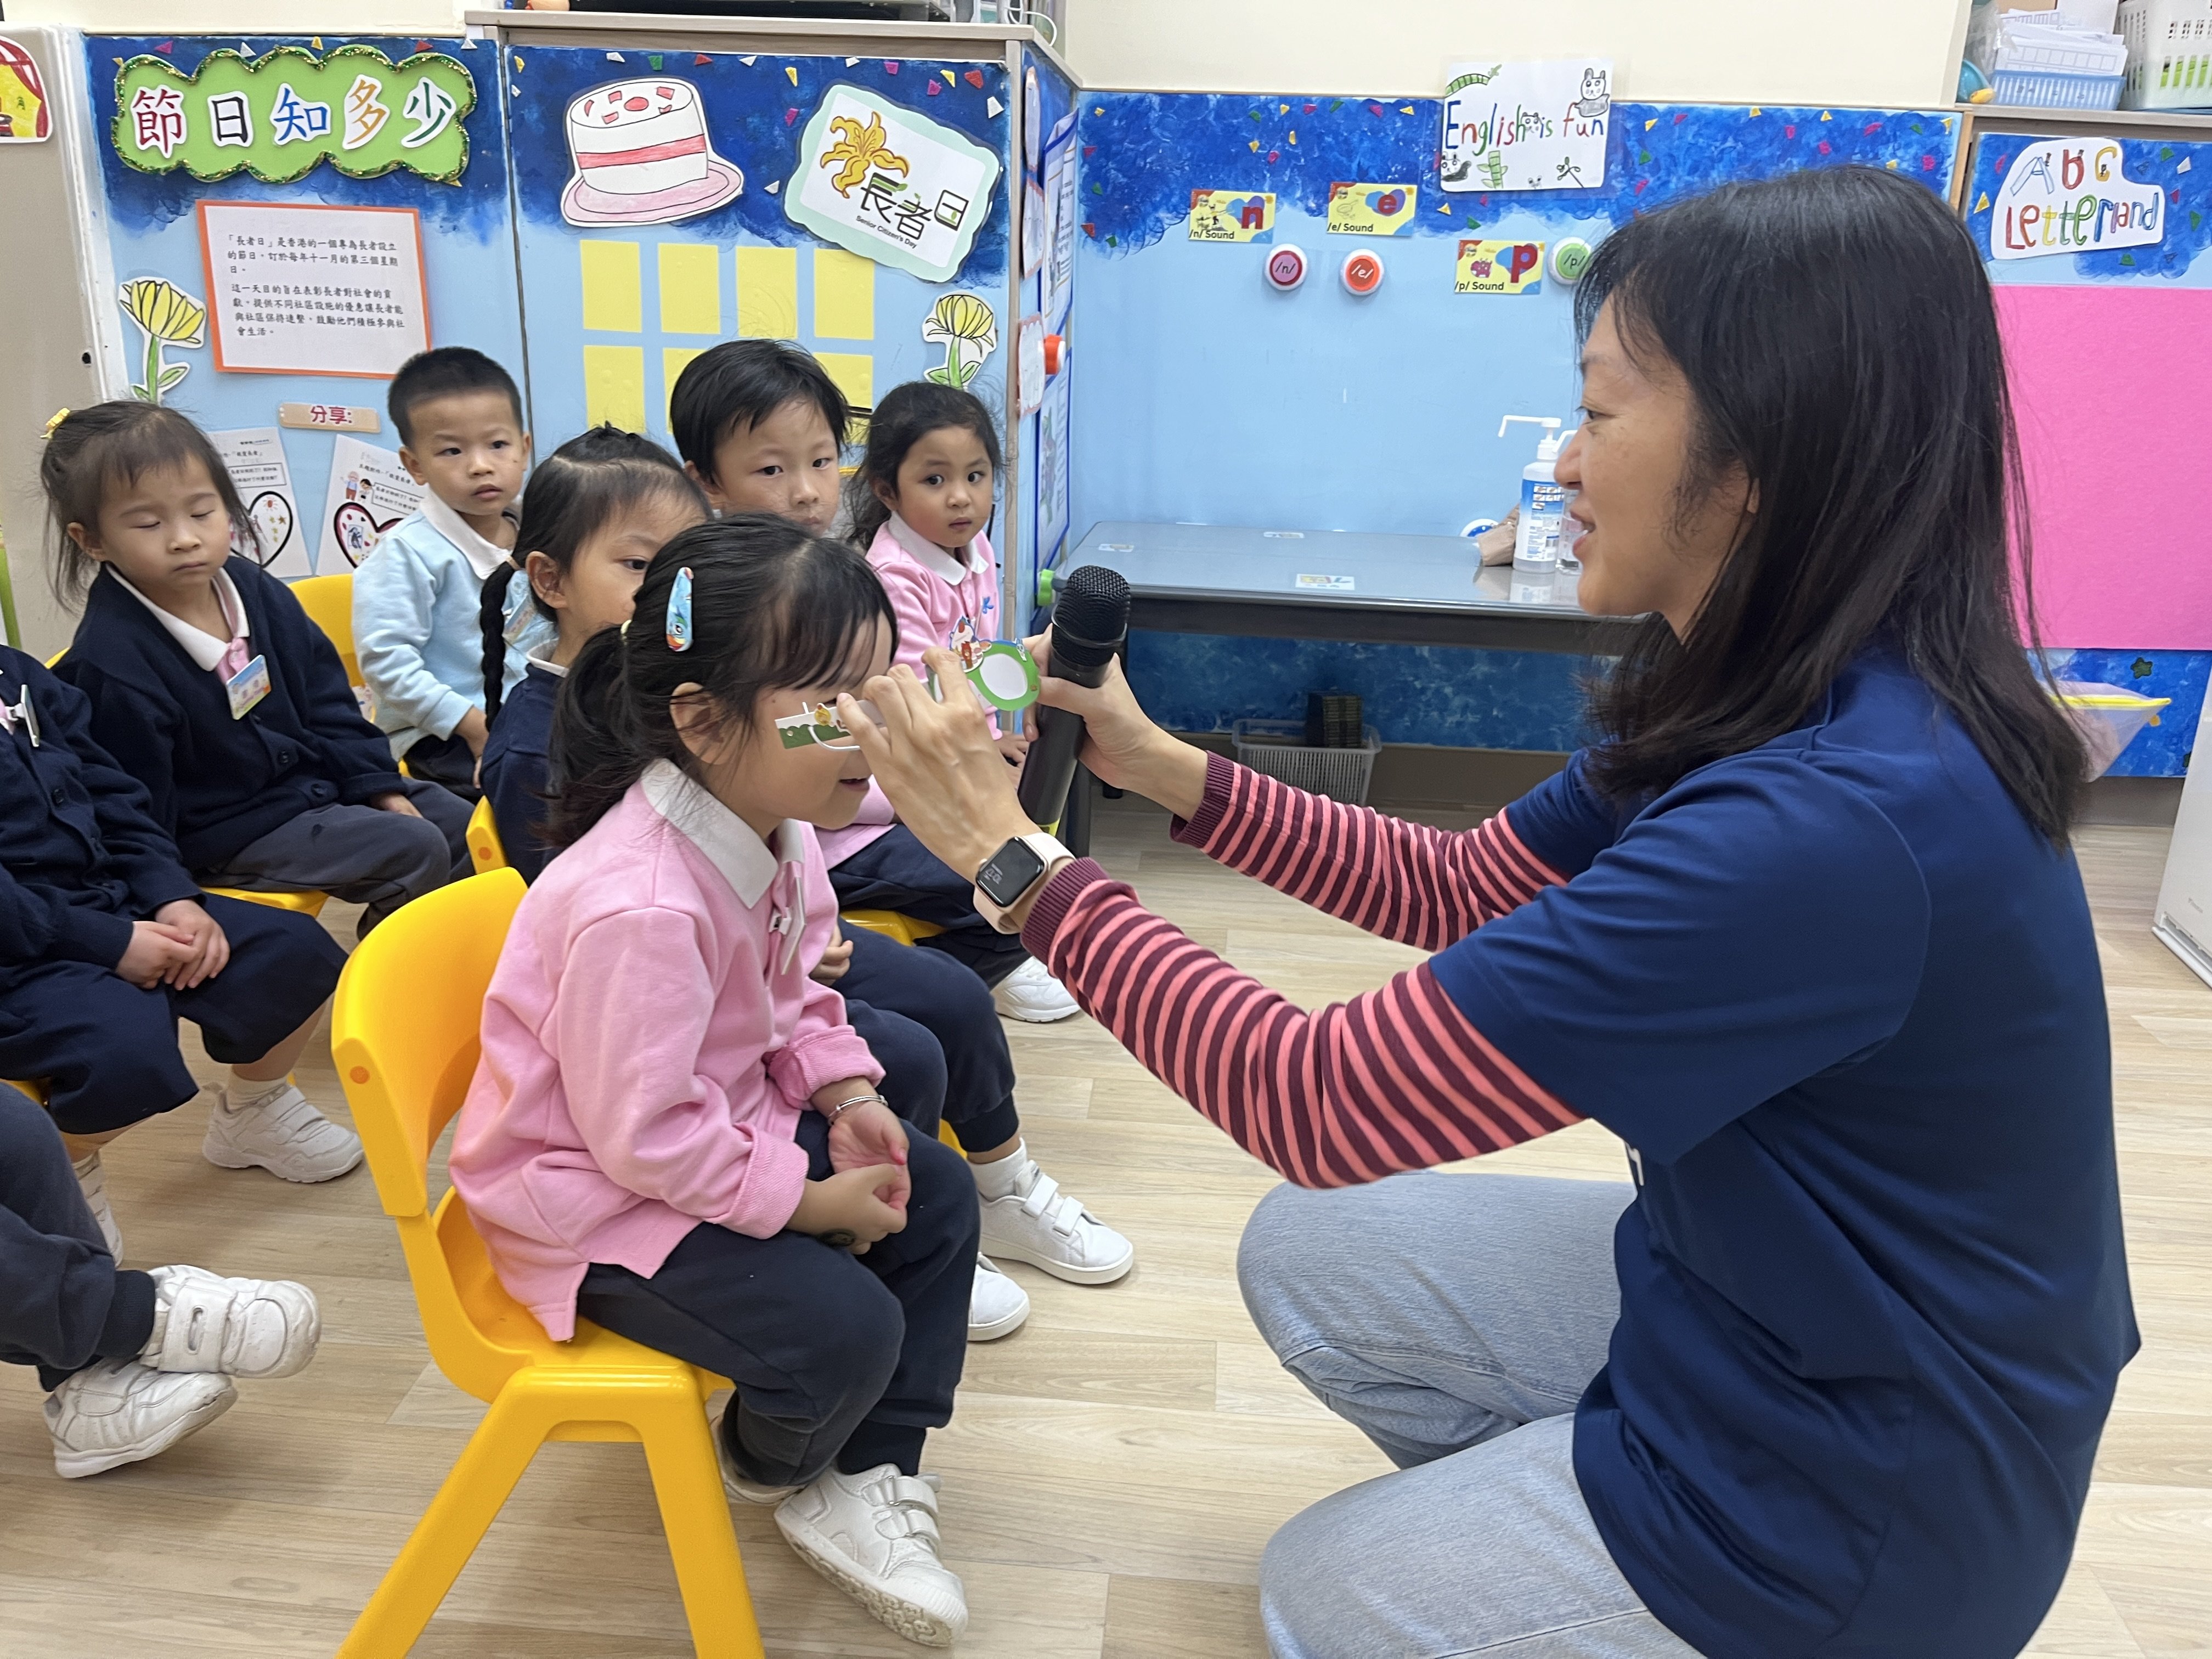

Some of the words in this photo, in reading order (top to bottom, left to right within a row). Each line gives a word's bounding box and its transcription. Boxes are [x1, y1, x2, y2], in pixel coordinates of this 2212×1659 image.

[133, 79, 452, 154] 節日知多少
[1445, 100, 1526, 156] English
[1539, 116, 1554, 139] is
[1562, 101, 1604, 138] fun
[860, 172, 969, 240] 長者日
[1377, 194, 1397, 214] e
[1241, 206, 1264, 230] n
[1327, 222, 1342, 232] /e/
[1343, 223, 1374, 233] Sound
[2005, 191, 2159, 250] Letterland
[856, 215, 877, 229] Senior
[877, 225, 904, 242] Citizen's
[904, 238, 918, 249] Day
[1188, 229, 1204, 239] /n/
[1205, 230, 1235, 240] Sound
[1275, 261, 1296, 274] /n/
[1351, 264, 1374, 279] /e/
[1510, 245, 1538, 284] p
[1454, 281, 1470, 292] /p/
[1472, 281, 1505, 291] Sound
